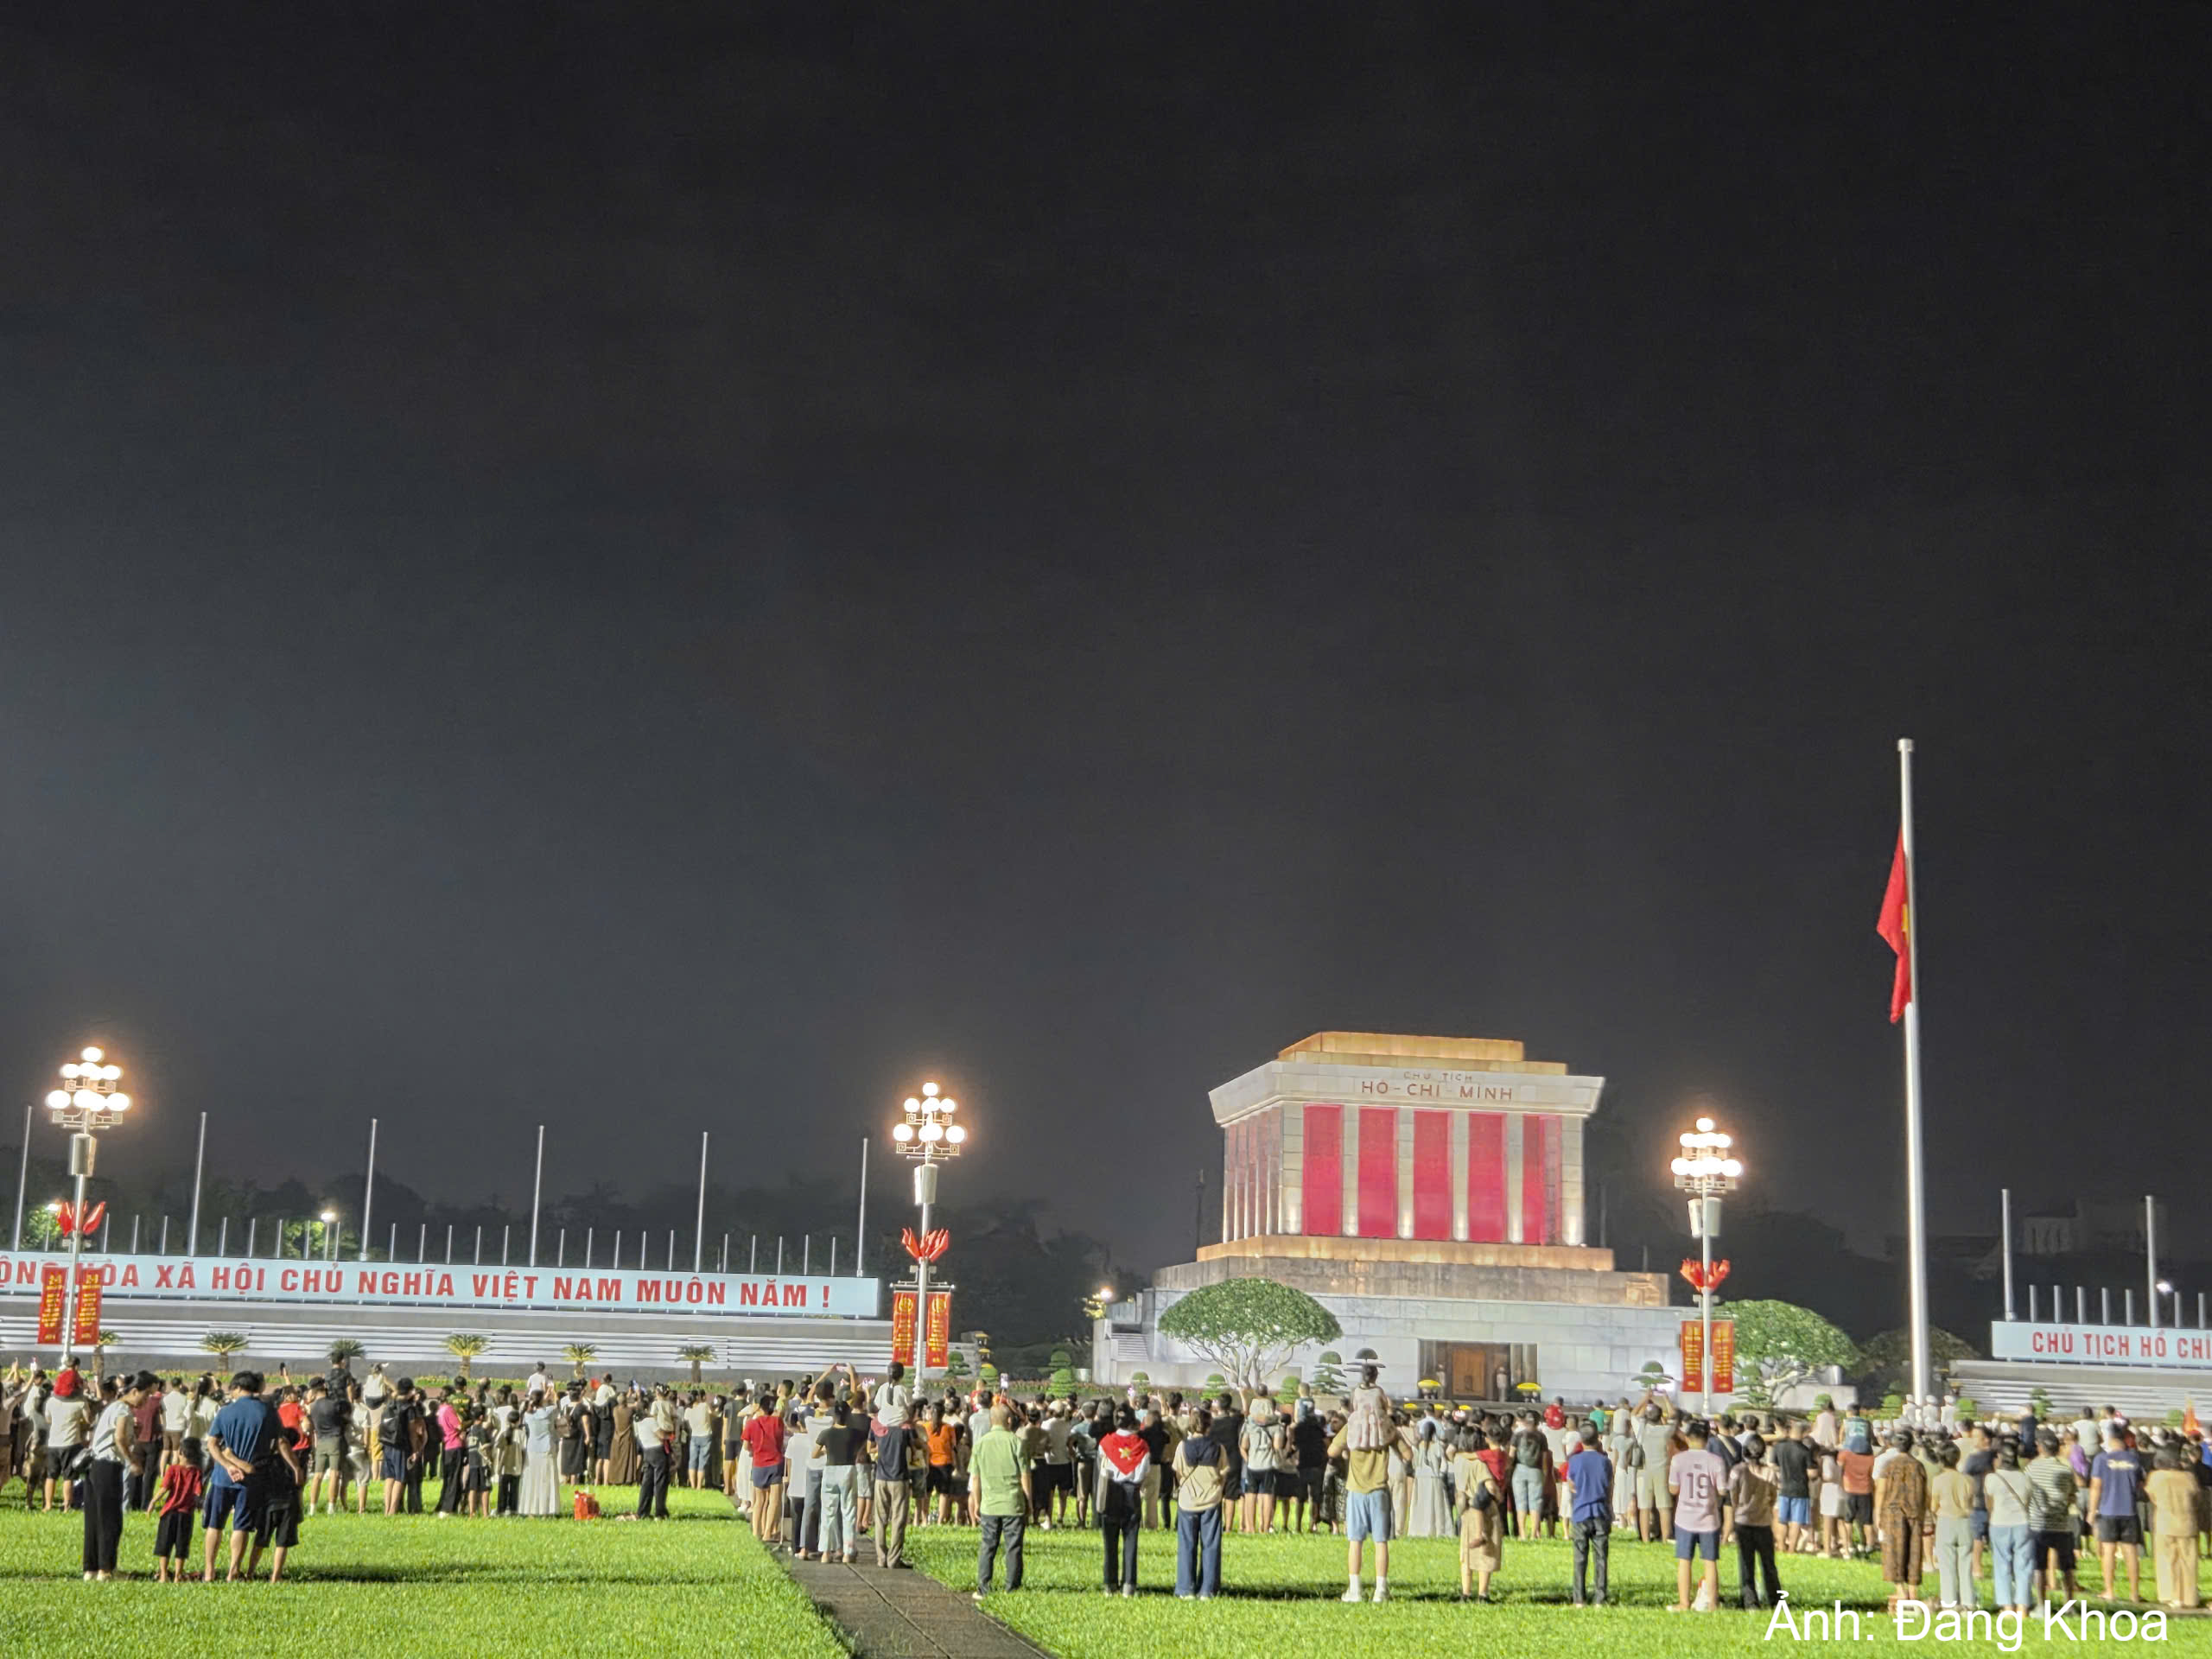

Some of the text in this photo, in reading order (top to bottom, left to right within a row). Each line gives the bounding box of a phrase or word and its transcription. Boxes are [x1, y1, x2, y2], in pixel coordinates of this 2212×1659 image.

[155, 1261, 196, 1288] XÃ
[212, 1262, 265, 1295] HỘI
[280, 1262, 344, 1293] CHỦ
[358, 1268, 454, 1296] NGHĨA
[473, 1270, 538, 1302] VIỆT
[553, 1276, 622, 1301] NAM
[636, 1276, 726, 1305] MUÔN
[740, 1278, 807, 1306] NĂM
[2032, 1325, 2074, 1354] CHỦ
[2083, 1333, 2130, 1359] TỊCH
[1686, 1471, 1712, 1499] 19
